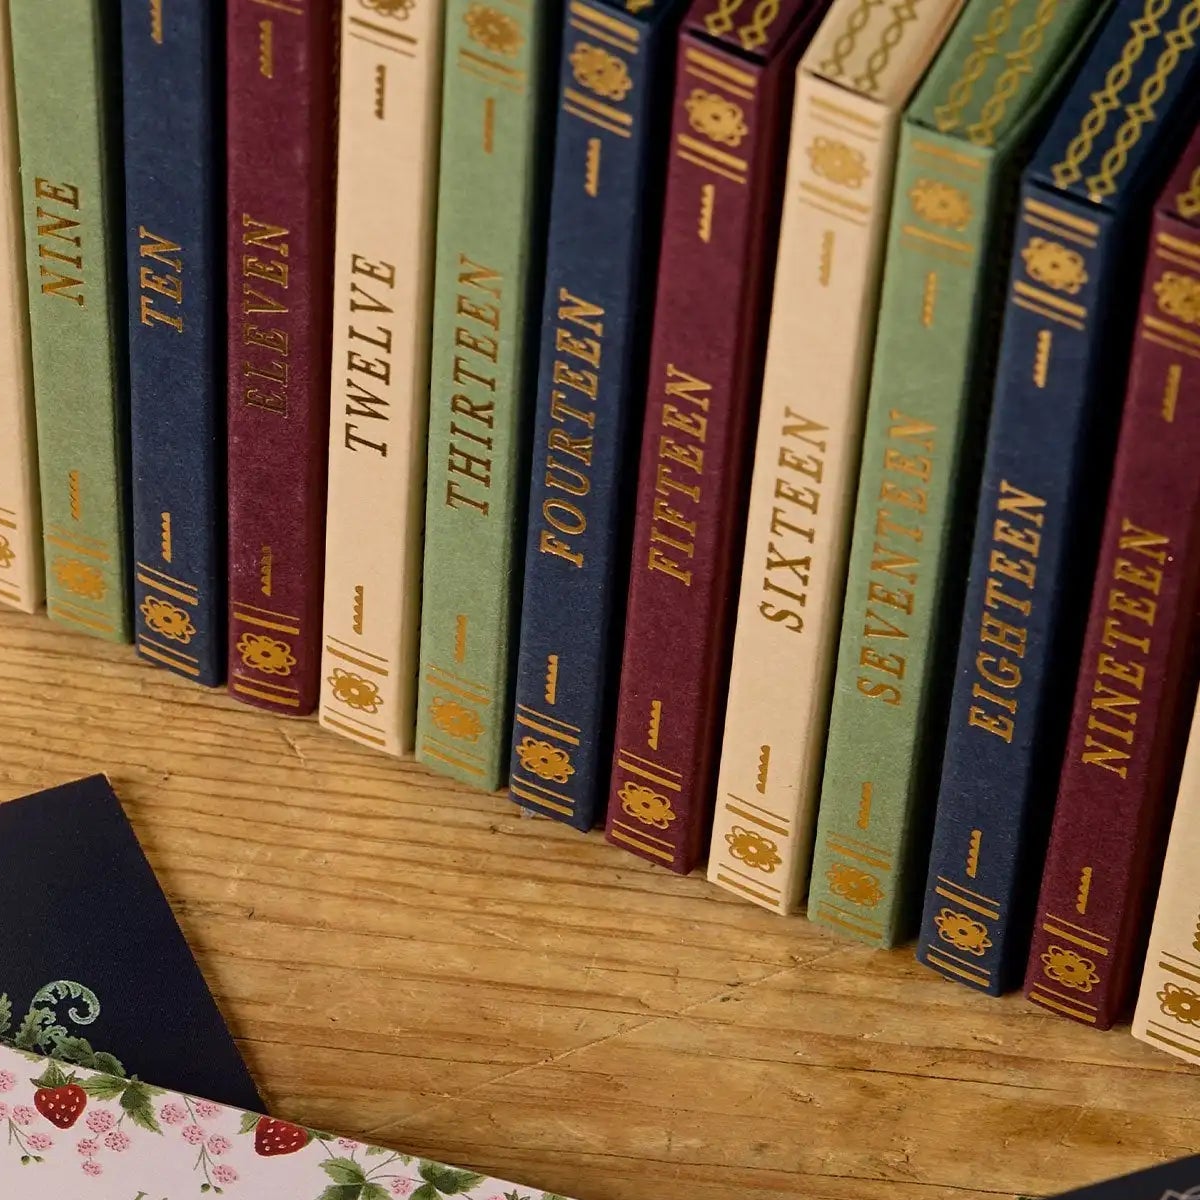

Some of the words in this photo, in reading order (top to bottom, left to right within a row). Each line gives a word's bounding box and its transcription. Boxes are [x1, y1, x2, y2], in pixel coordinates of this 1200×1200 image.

[34, 177, 85, 306] NINE
[138, 225, 184, 333] TEN
[243, 213, 292, 417] ELEVEN
[344, 253, 397, 457] TWELVE
[446, 253, 502, 516] THIRTEEN
[540, 287, 607, 568] FOURTEEN
[647, 364, 714, 586] FIFTEEN
[759, 406, 831, 633] SIXTEEN
[857, 410, 937, 706] SEVENTEEN
[967, 481, 1048, 744] EIGHTEEN
[1083, 520, 1171, 777] NINETEEN
